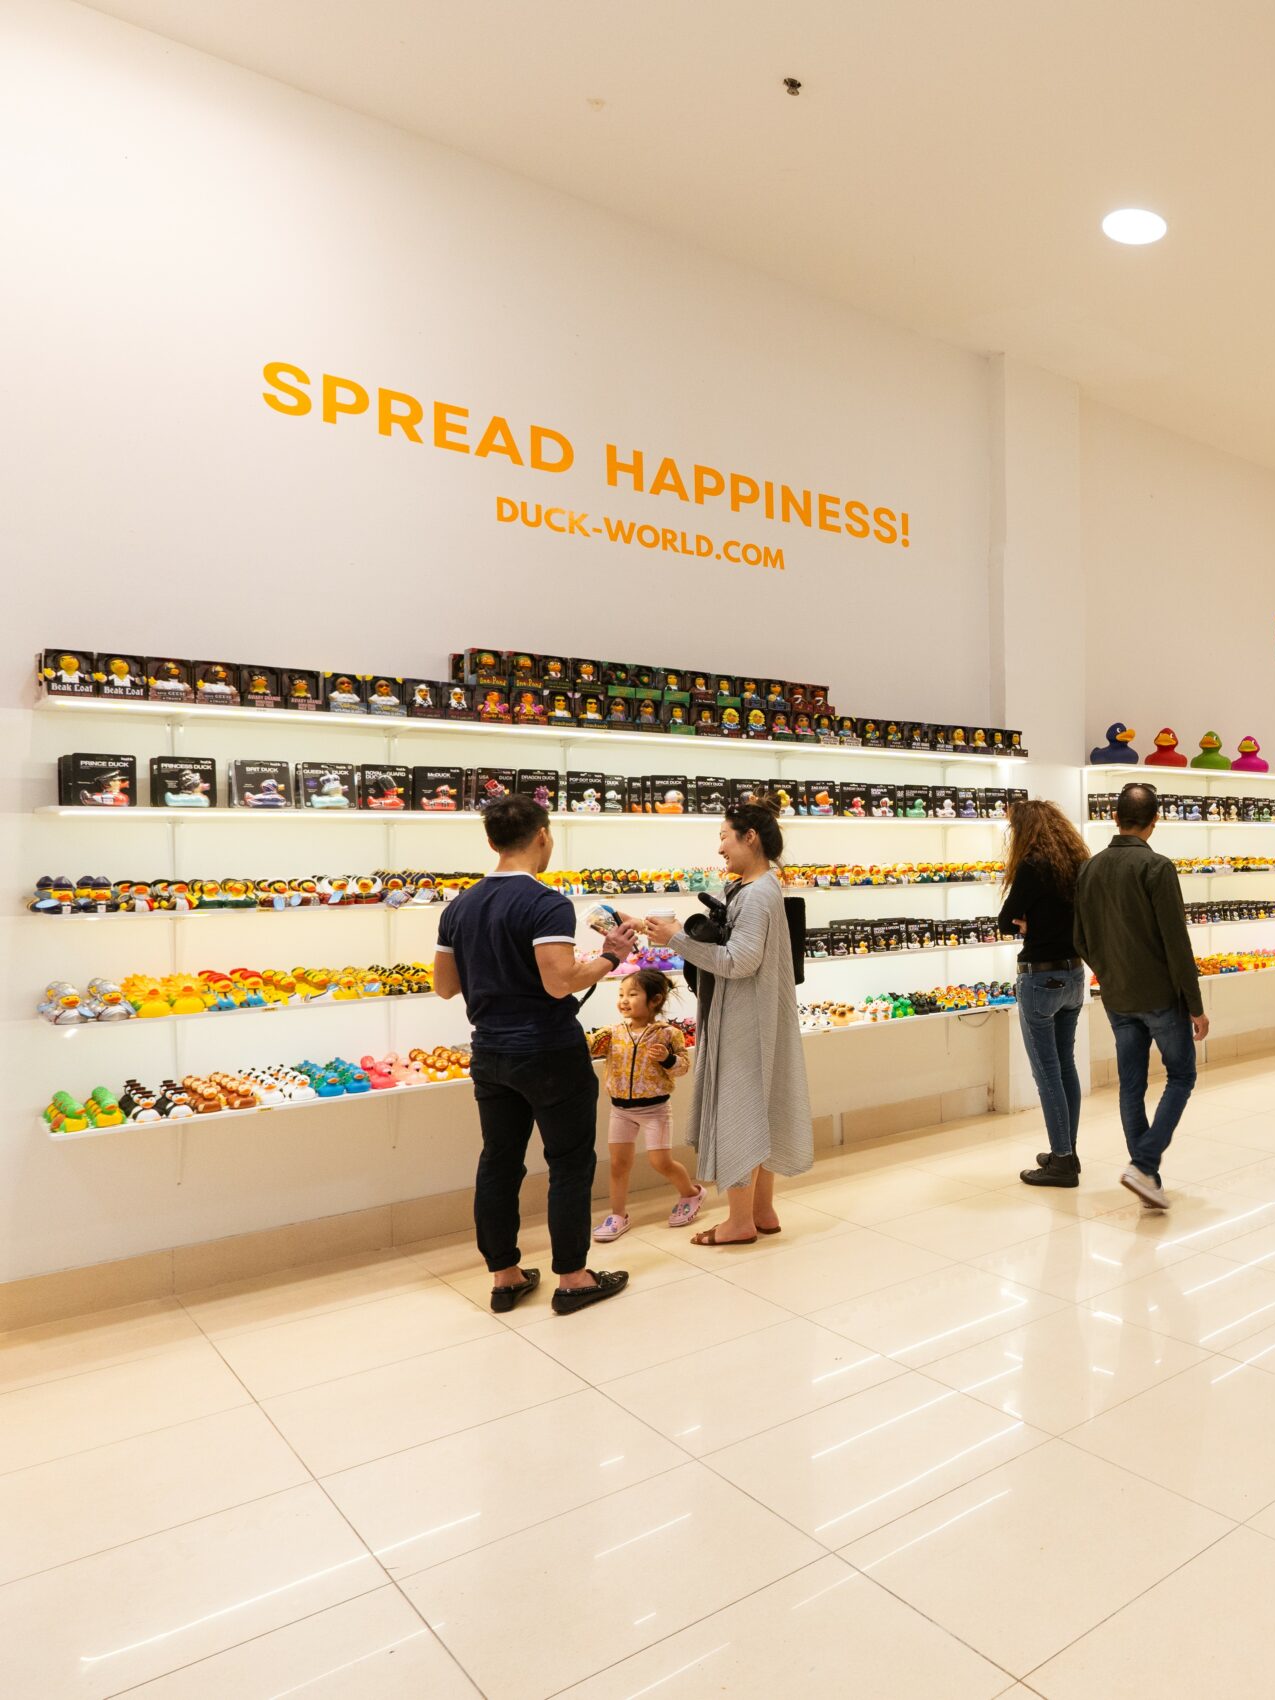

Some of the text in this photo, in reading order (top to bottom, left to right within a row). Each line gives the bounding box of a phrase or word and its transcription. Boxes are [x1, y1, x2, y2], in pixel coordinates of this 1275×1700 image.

[262, 361, 910, 548] SPREAD HAPPINESS!
[496, 496, 785, 570] DUCK-WORLD.COM
